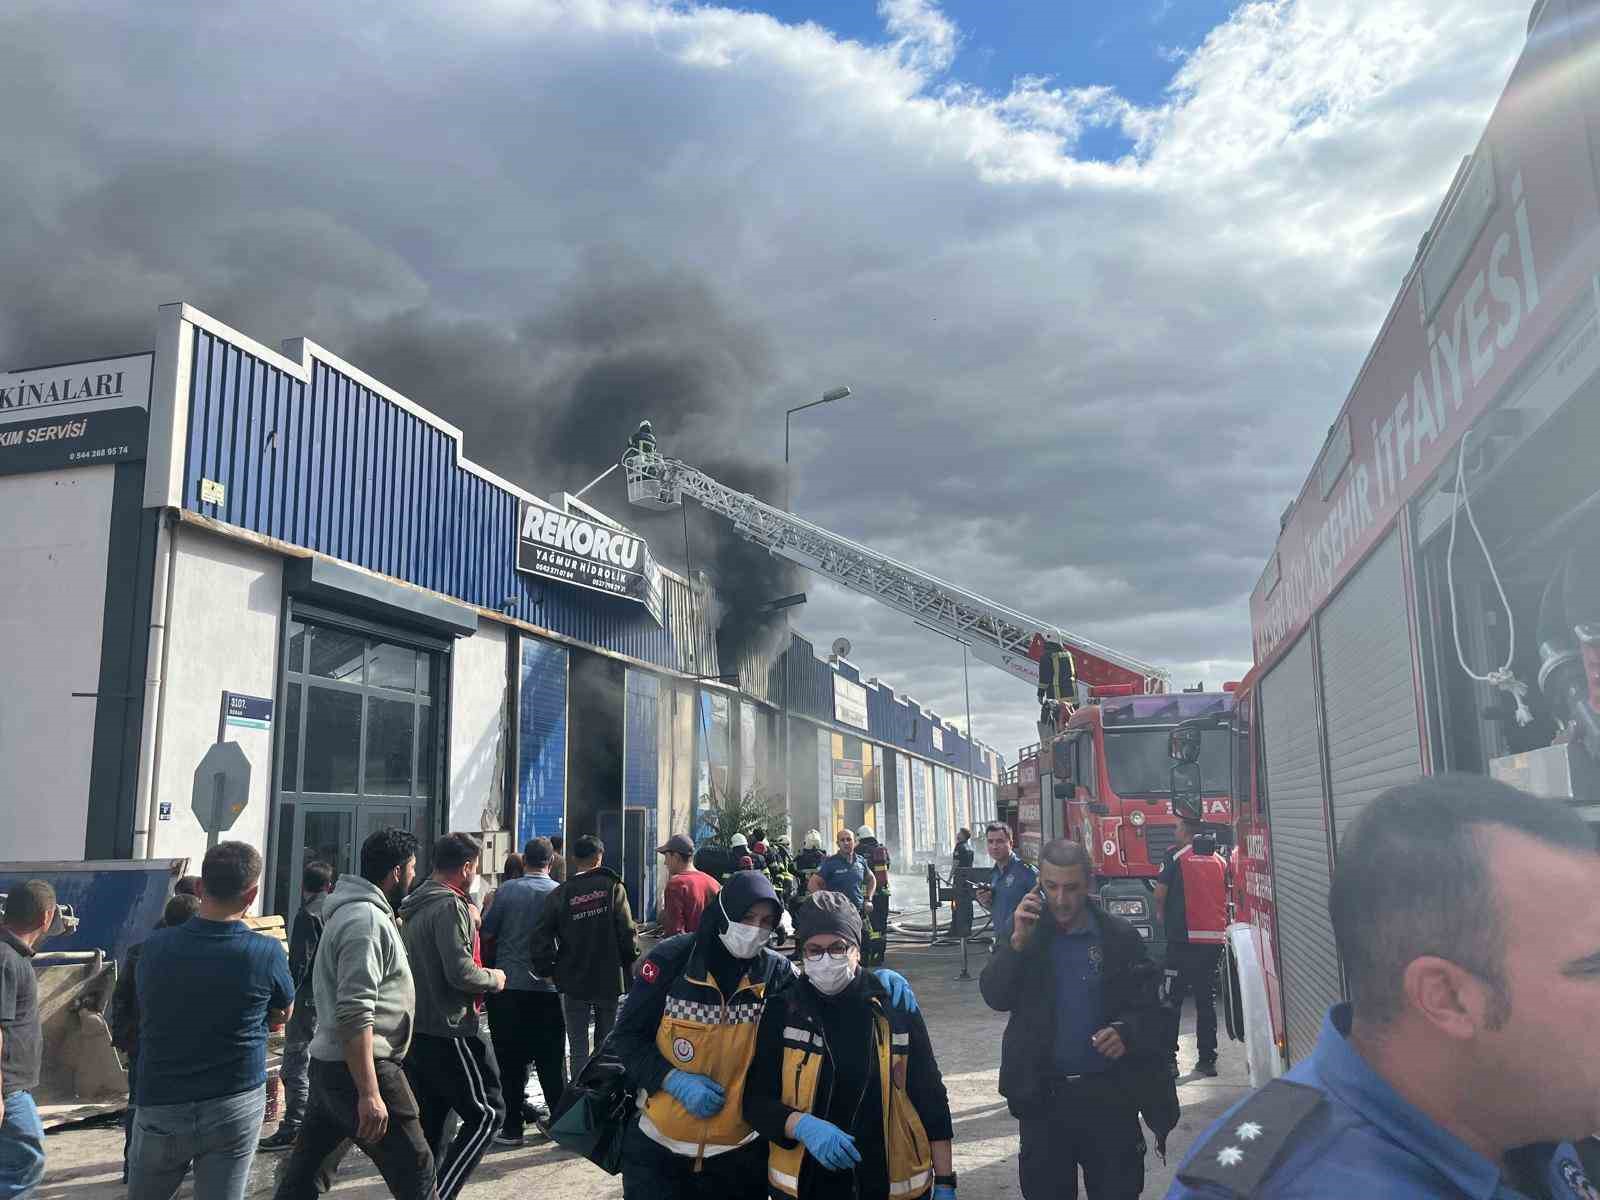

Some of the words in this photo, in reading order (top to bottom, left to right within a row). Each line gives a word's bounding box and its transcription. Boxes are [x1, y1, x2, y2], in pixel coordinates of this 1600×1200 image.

[1371, 171, 1540, 508] İTFAİYESİ
[0, 372, 125, 408] KİNALARI
[26, 419, 87, 443] SERVİSİ
[522, 505, 640, 568] REKORCU
[536, 549, 578, 570] YAĞMUR
[580, 561, 626, 583] HİDROLİK
[1105, 842, 1112, 854] 9
